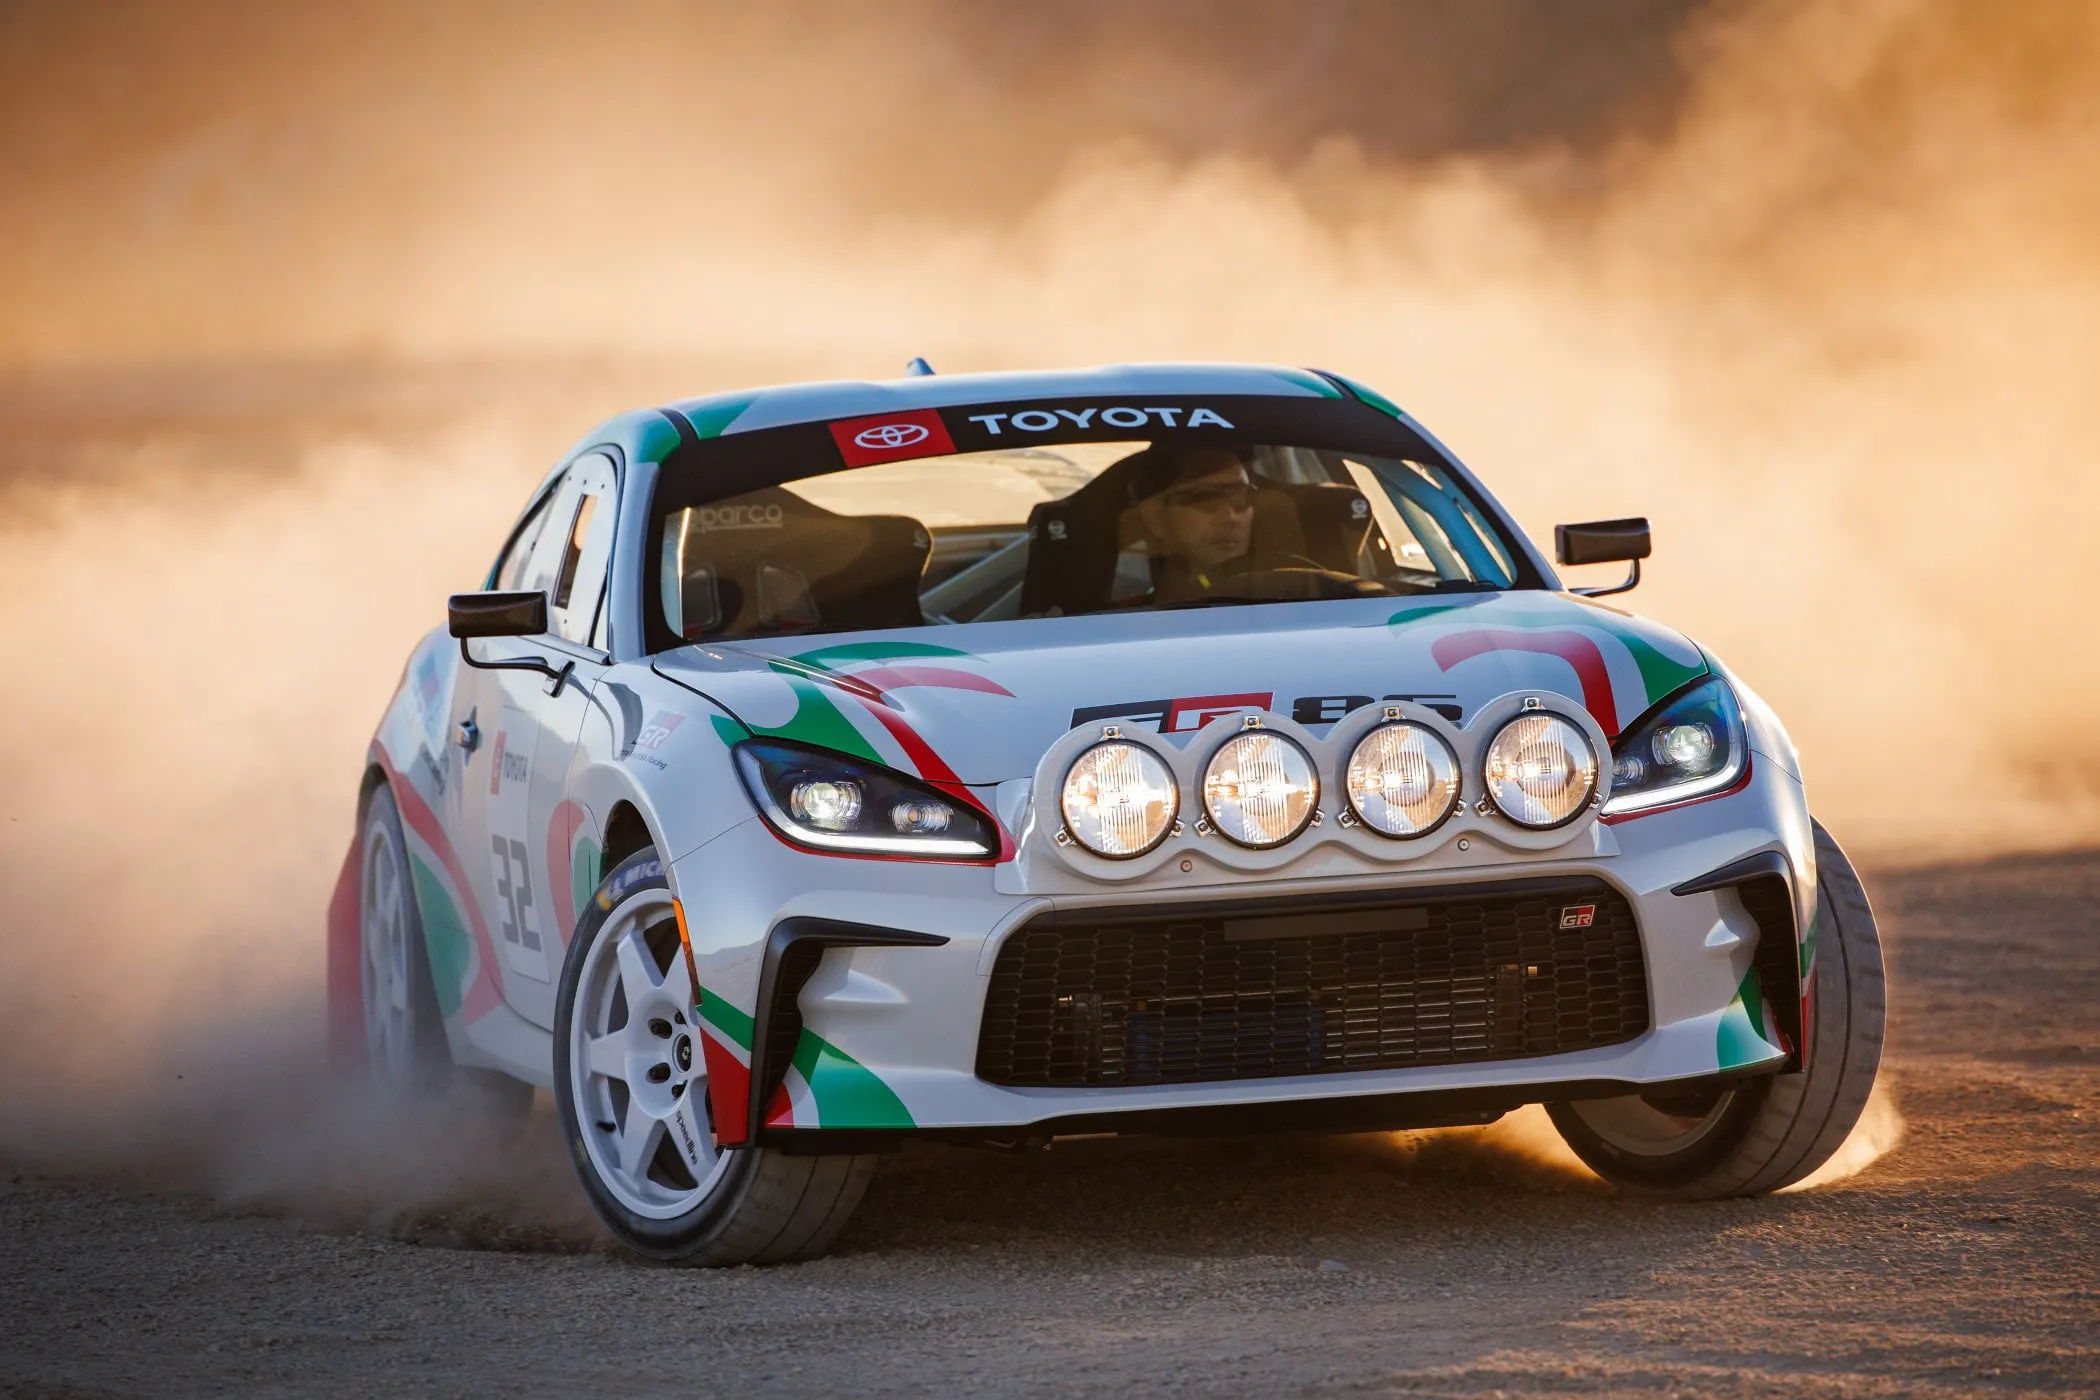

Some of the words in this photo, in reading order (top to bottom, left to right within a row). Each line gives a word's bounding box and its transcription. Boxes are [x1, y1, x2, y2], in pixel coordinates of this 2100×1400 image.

[969, 407, 1235, 435] TOYOTA
[638, 722, 674, 750] GR
[492, 834, 542, 952] 32
[1560, 911, 1593, 928] GR
